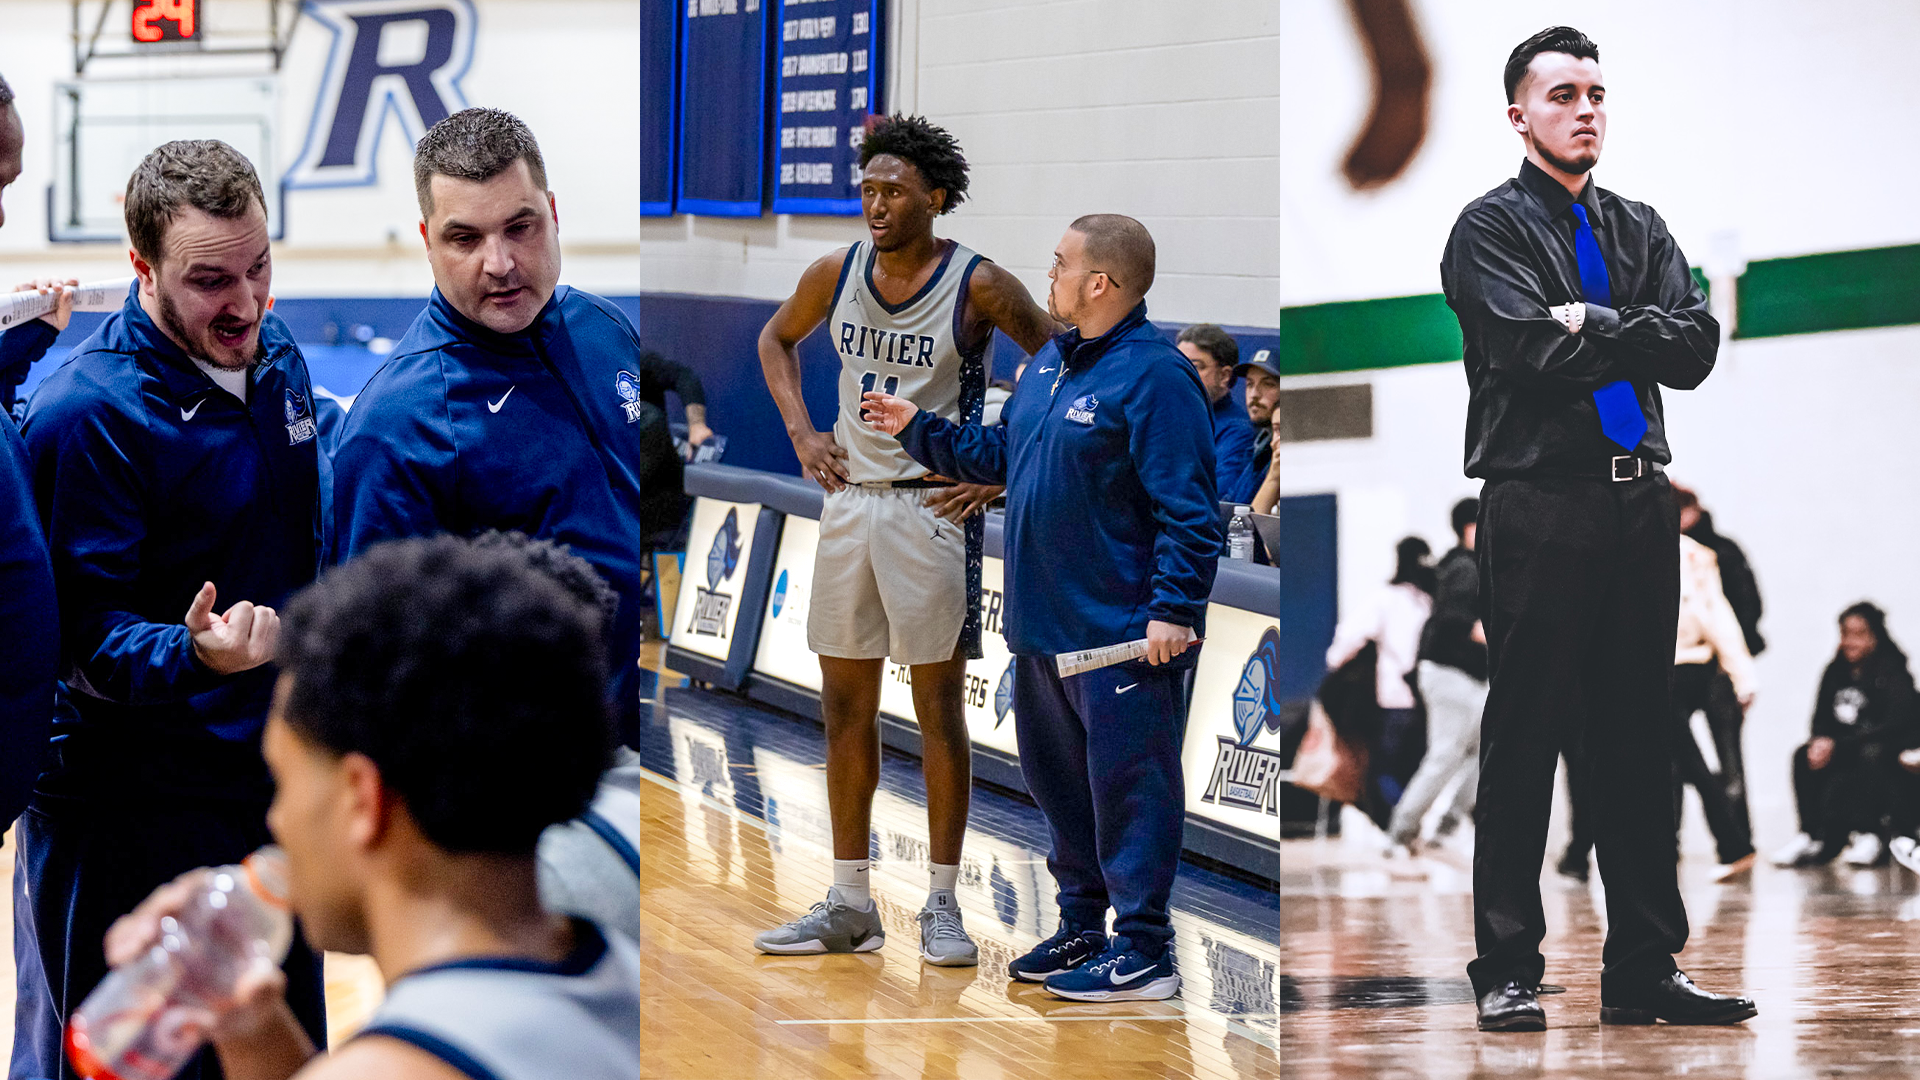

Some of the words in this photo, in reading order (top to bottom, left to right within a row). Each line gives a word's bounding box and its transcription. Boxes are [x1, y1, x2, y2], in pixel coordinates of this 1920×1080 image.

[132, 0, 195, 42] 24
[300, 3, 465, 178] R
[839, 320, 936, 370] RIVIER
[1201, 735, 1280, 816] RIVIER
